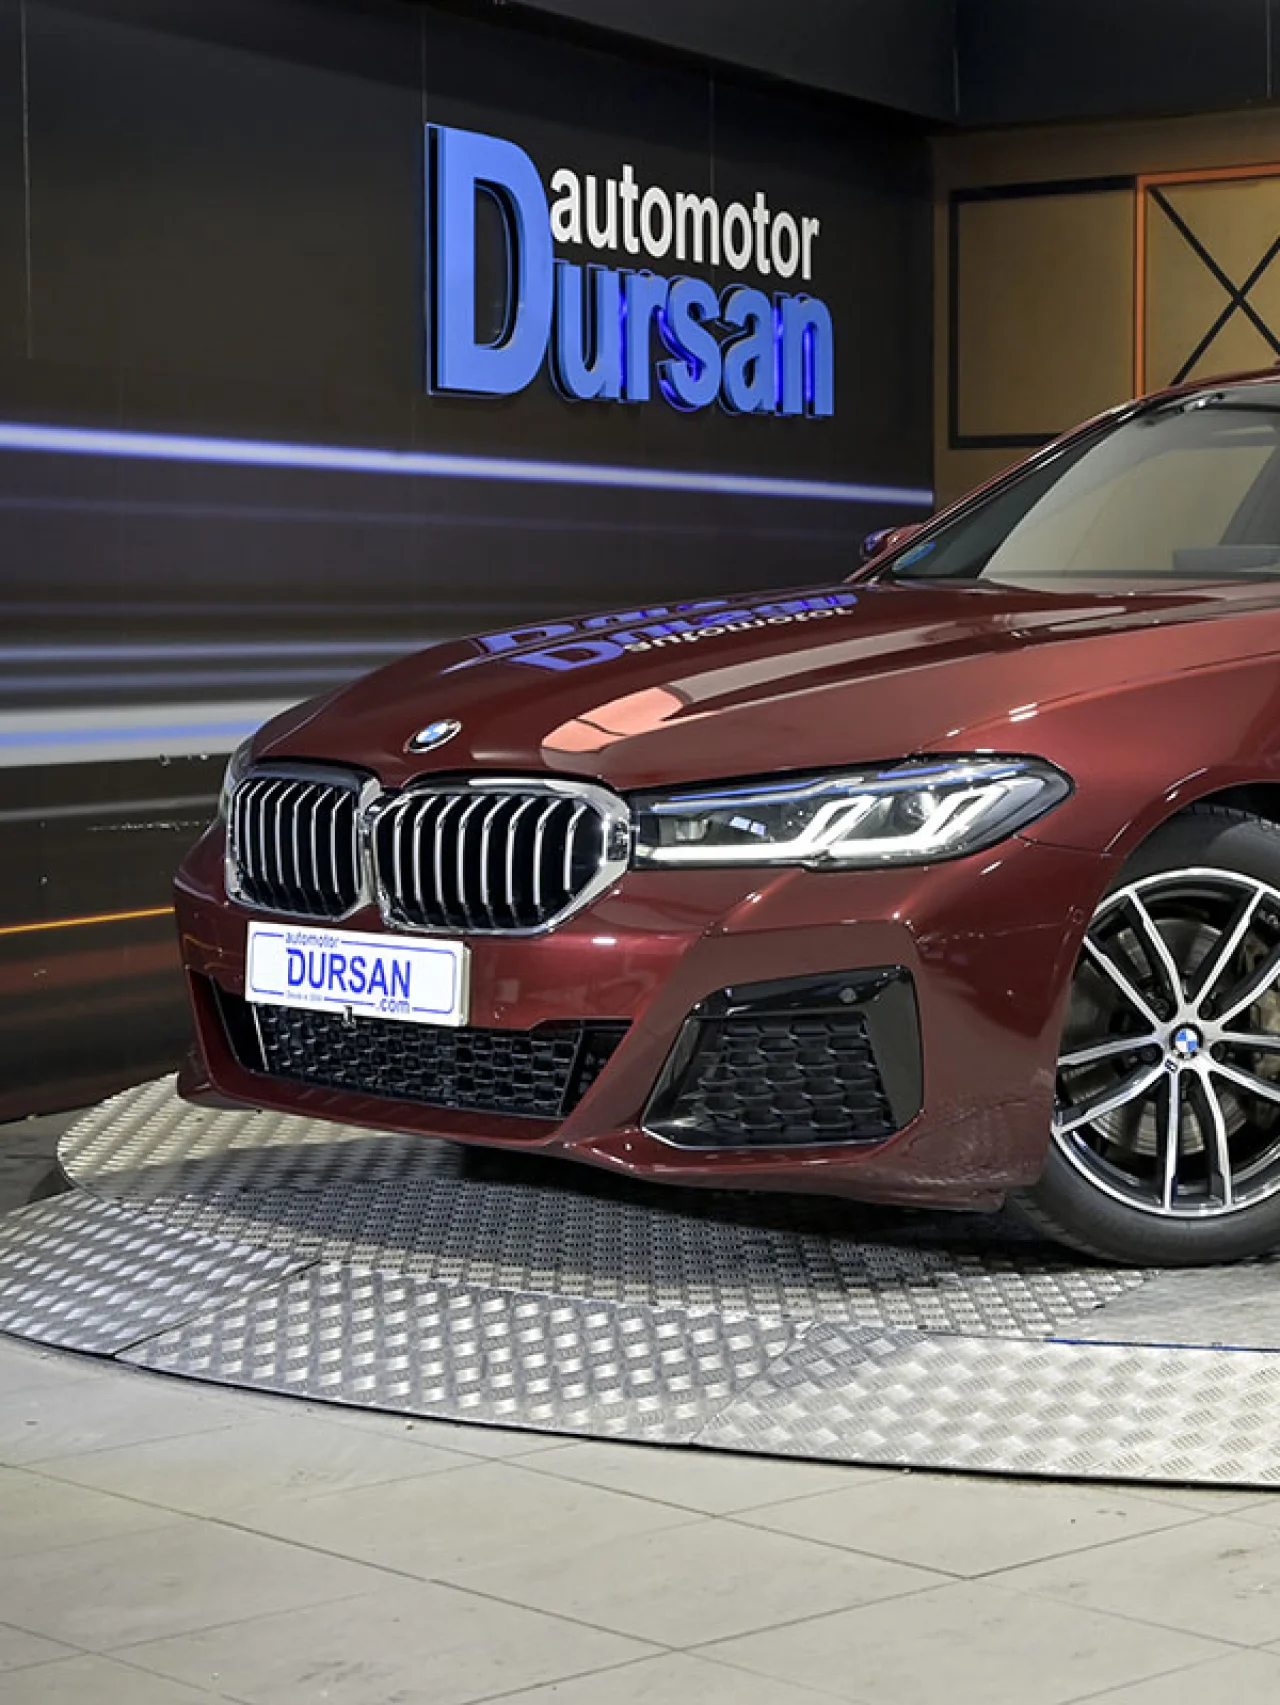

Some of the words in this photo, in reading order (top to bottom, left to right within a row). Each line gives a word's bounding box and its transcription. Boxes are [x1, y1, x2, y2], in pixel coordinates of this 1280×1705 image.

[550, 164, 820, 280] automotor
[426, 123, 834, 418] Dursan
[285, 932, 340, 948] automotor
[286, 947, 411, 999] DURSAN
